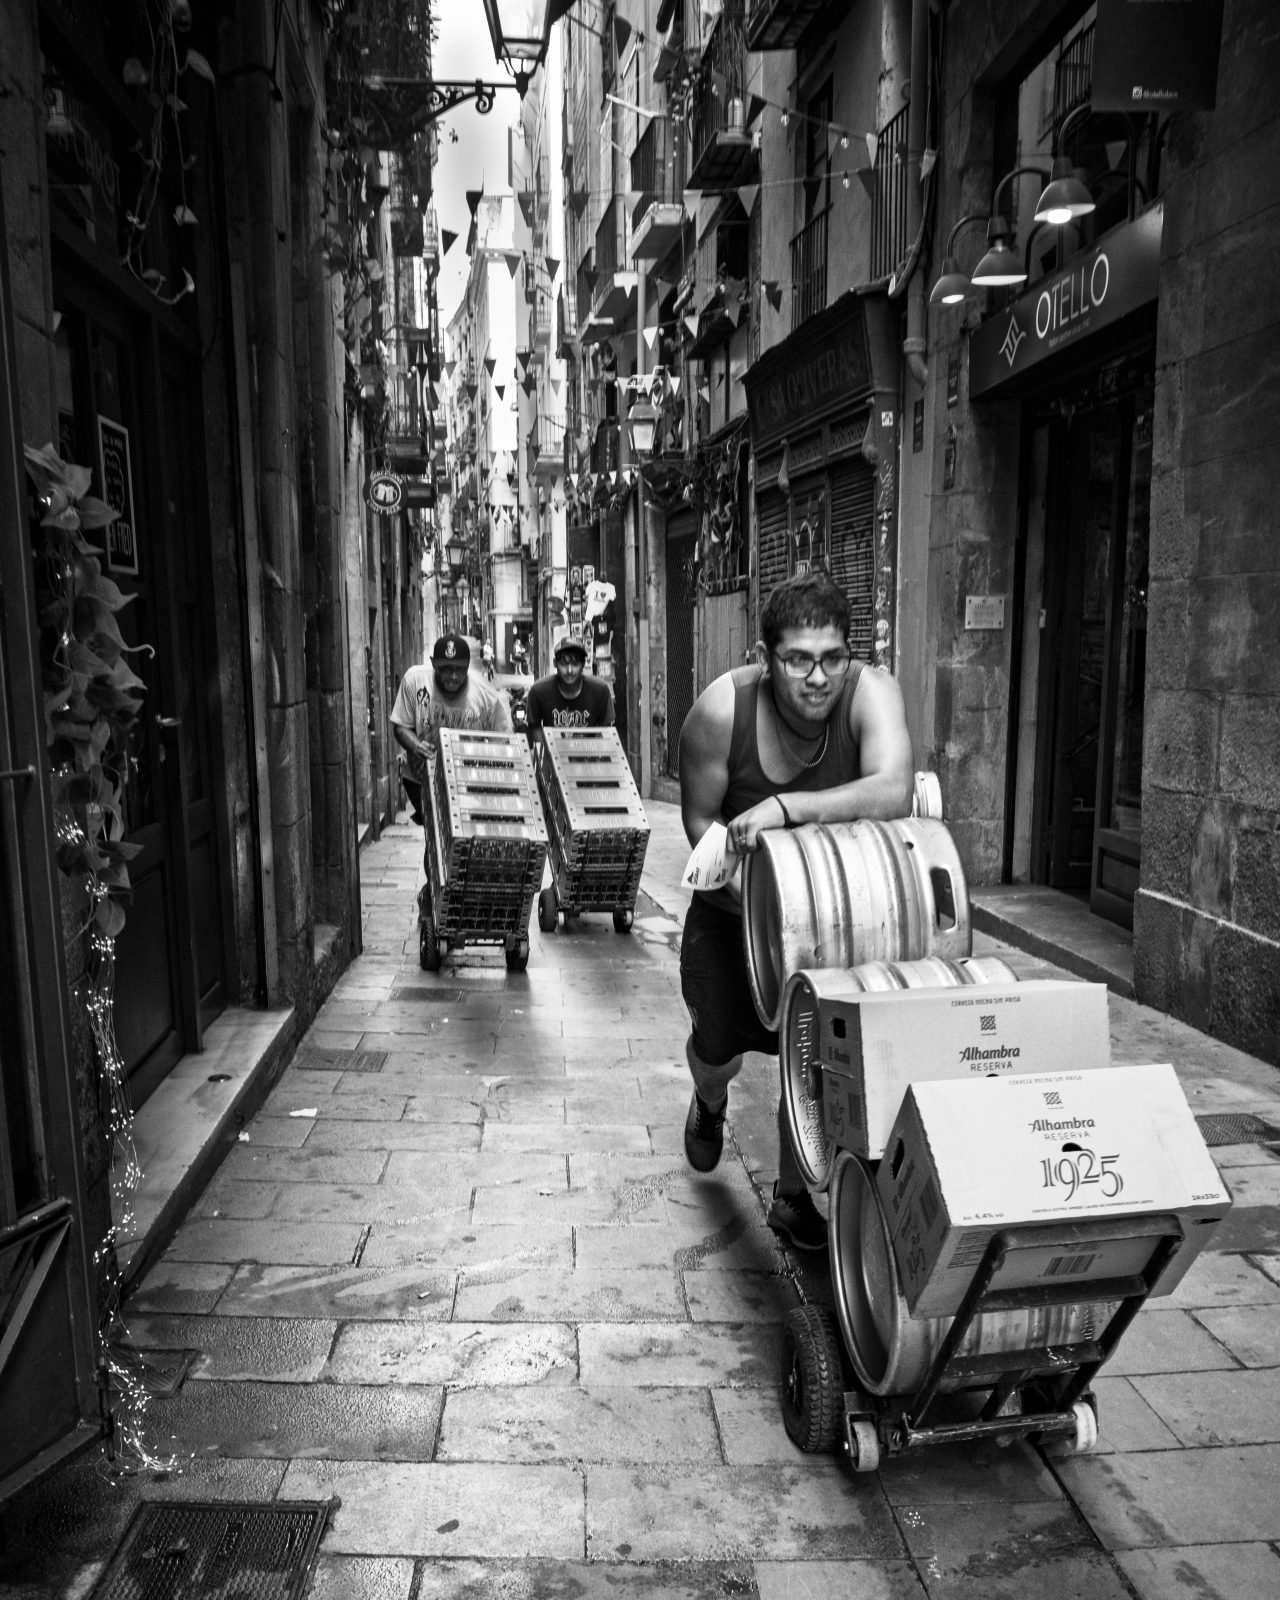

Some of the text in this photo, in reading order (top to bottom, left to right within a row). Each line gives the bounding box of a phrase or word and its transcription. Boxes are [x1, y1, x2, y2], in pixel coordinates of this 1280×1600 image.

[1036, 253, 1109, 339] OTELLO
[959, 1044, 1020, 1063] Alhambra
[970, 1060, 1013, 1072] RESERVA
[1028, 1116, 1096, 1134] Alhambra
[1043, 1130, 1091, 1142] RESERVA
[1040, 1148, 1124, 1202] 1925
